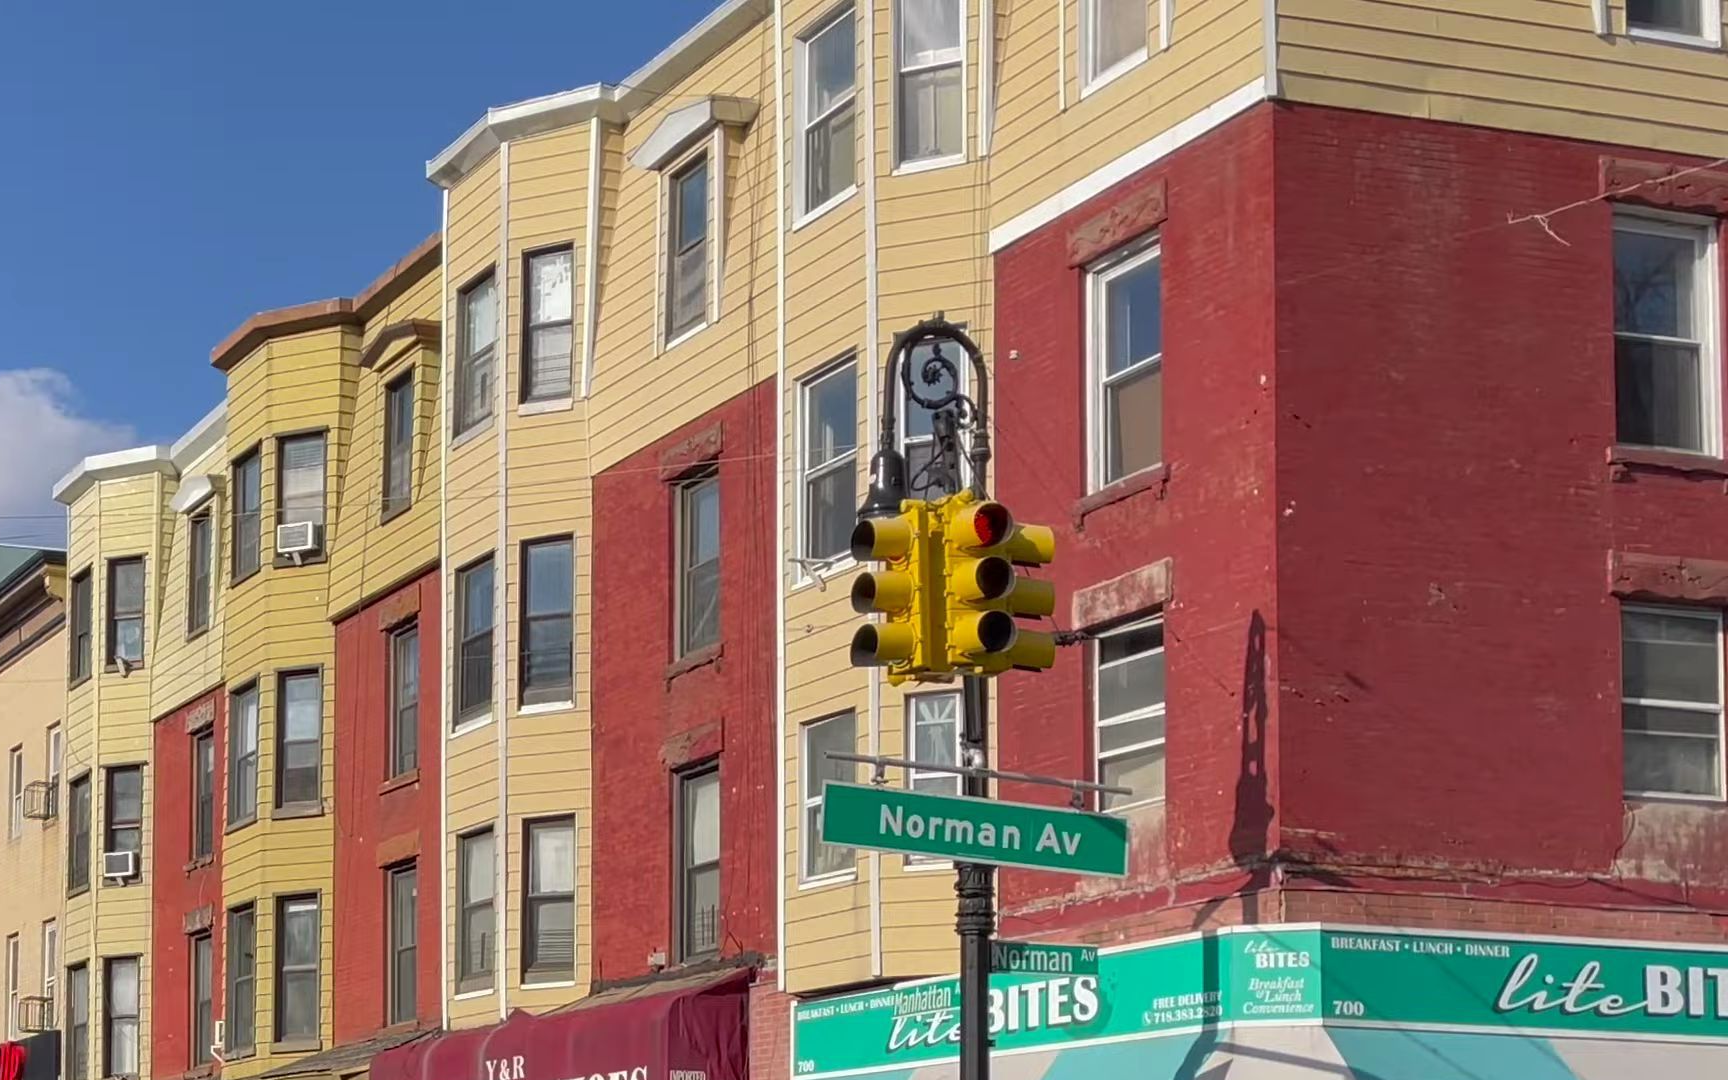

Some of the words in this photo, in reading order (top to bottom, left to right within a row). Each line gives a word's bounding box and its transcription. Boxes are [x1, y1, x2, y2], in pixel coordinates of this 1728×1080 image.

[879, 803, 1021, 851] Norman
[1035, 822, 1082, 856] Av
[1331, 936, 1401, 953] BREAKFAST
[1412, 941, 1454, 956] LUNCH
[1464, 943, 1511, 958] DINNER
[994, 944, 1073, 973] Norman
[1080, 950, 1096, 963] Av
[1255, 952, 1311, 969] BITES
[1248, 977, 1305, 993] Breakfast
[1496, 952, 1649, 1015] lite
[894, 986, 952, 1016] Manhattan
[1152, 997, 1175, 1010] FREE
[1178, 990, 1222, 1007] DELIVERY
[1264, 990, 1303, 1003] Lunch
[797, 1004, 835, 1021] BREAKFAST
[839, 1001, 864, 1014] LUNCH
[1242, 1001, 1315, 1014] Convenience
[1332, 1000, 1365, 1016] 700
[797, 1061, 815, 1072] 700
